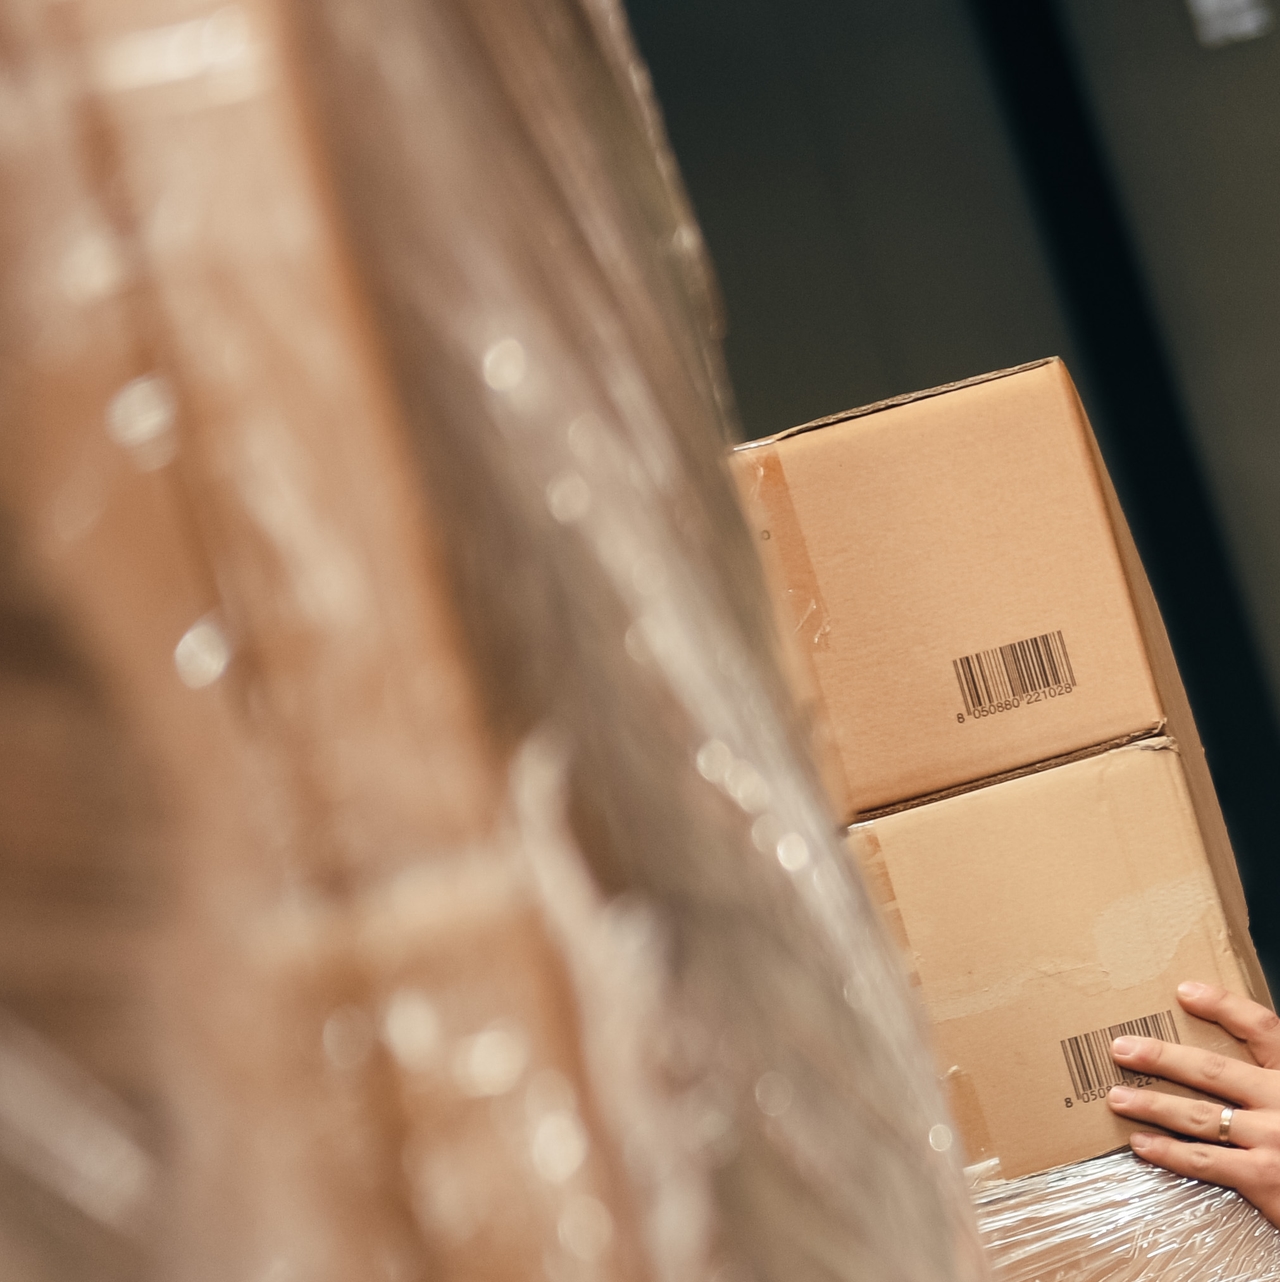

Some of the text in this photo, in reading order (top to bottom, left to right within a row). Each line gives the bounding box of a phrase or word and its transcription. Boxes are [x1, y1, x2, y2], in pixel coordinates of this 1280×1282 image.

[956, 682, 1073, 723] 8 050880 221028
[1063, 1097, 1073, 1108] 8
